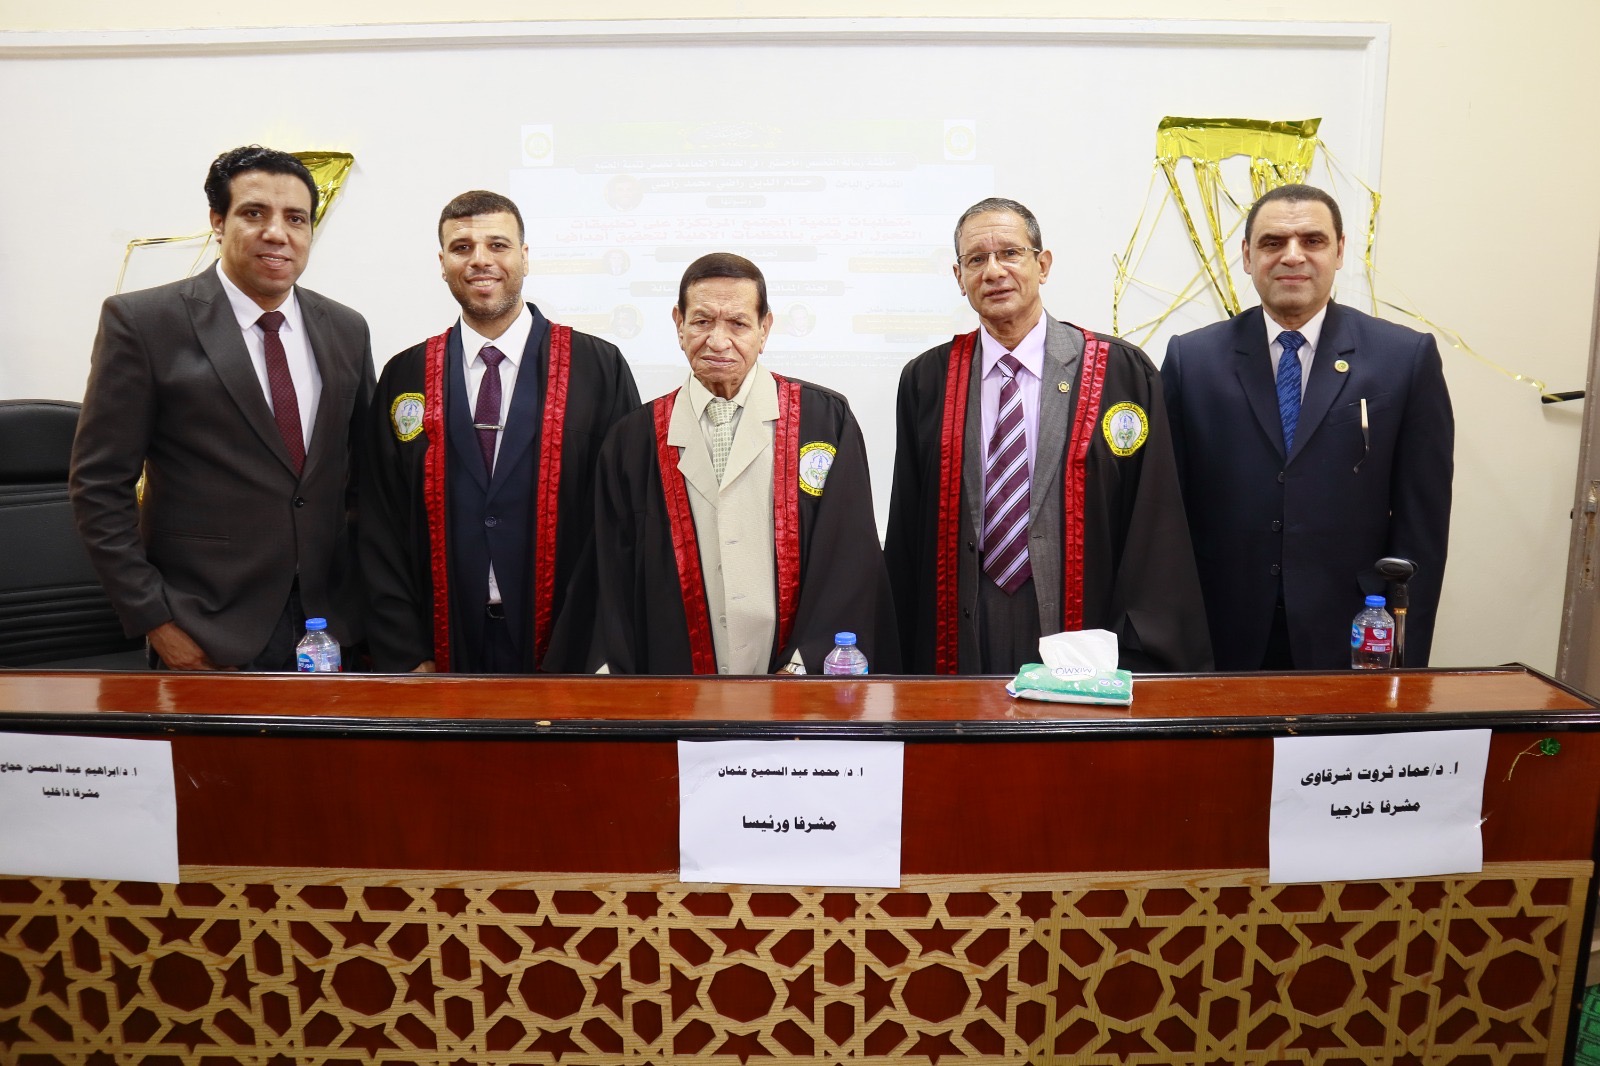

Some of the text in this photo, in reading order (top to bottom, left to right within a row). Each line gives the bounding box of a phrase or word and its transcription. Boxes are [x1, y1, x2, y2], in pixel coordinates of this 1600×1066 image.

[682, 180, 711, 189] محمد
[747, 178, 779, 190] الدين
[782, 178, 812, 189] حسام
[570, 219, 636, 231] تطبيقات
[642, 219, 672, 230] على
[743, 218, 791, 230] المجتمع
[799, 216, 841, 229] تنمية
[616, 231, 668, 243] لتحقيق
[0, 762, 23, 773] حجاج
[27, 764, 62, 774] المحسن
[65, 765, 81, 776] عبد
[718, 766, 748, 777] عثمان
[751, 766, 788, 778] السميع
[791, 767, 809, 778] عبد
[812, 767, 840, 777] محمد
[1300, 767, 1352, 786] شرقاوى
[1357, 765, 1394, 783] ثروت
[42, 787, 100, 800] مشرفا داخليا
[1330, 799, 1421, 819] مشرفا خارجيا
[742, 815, 837, 833] مشرفا ورئيسا
